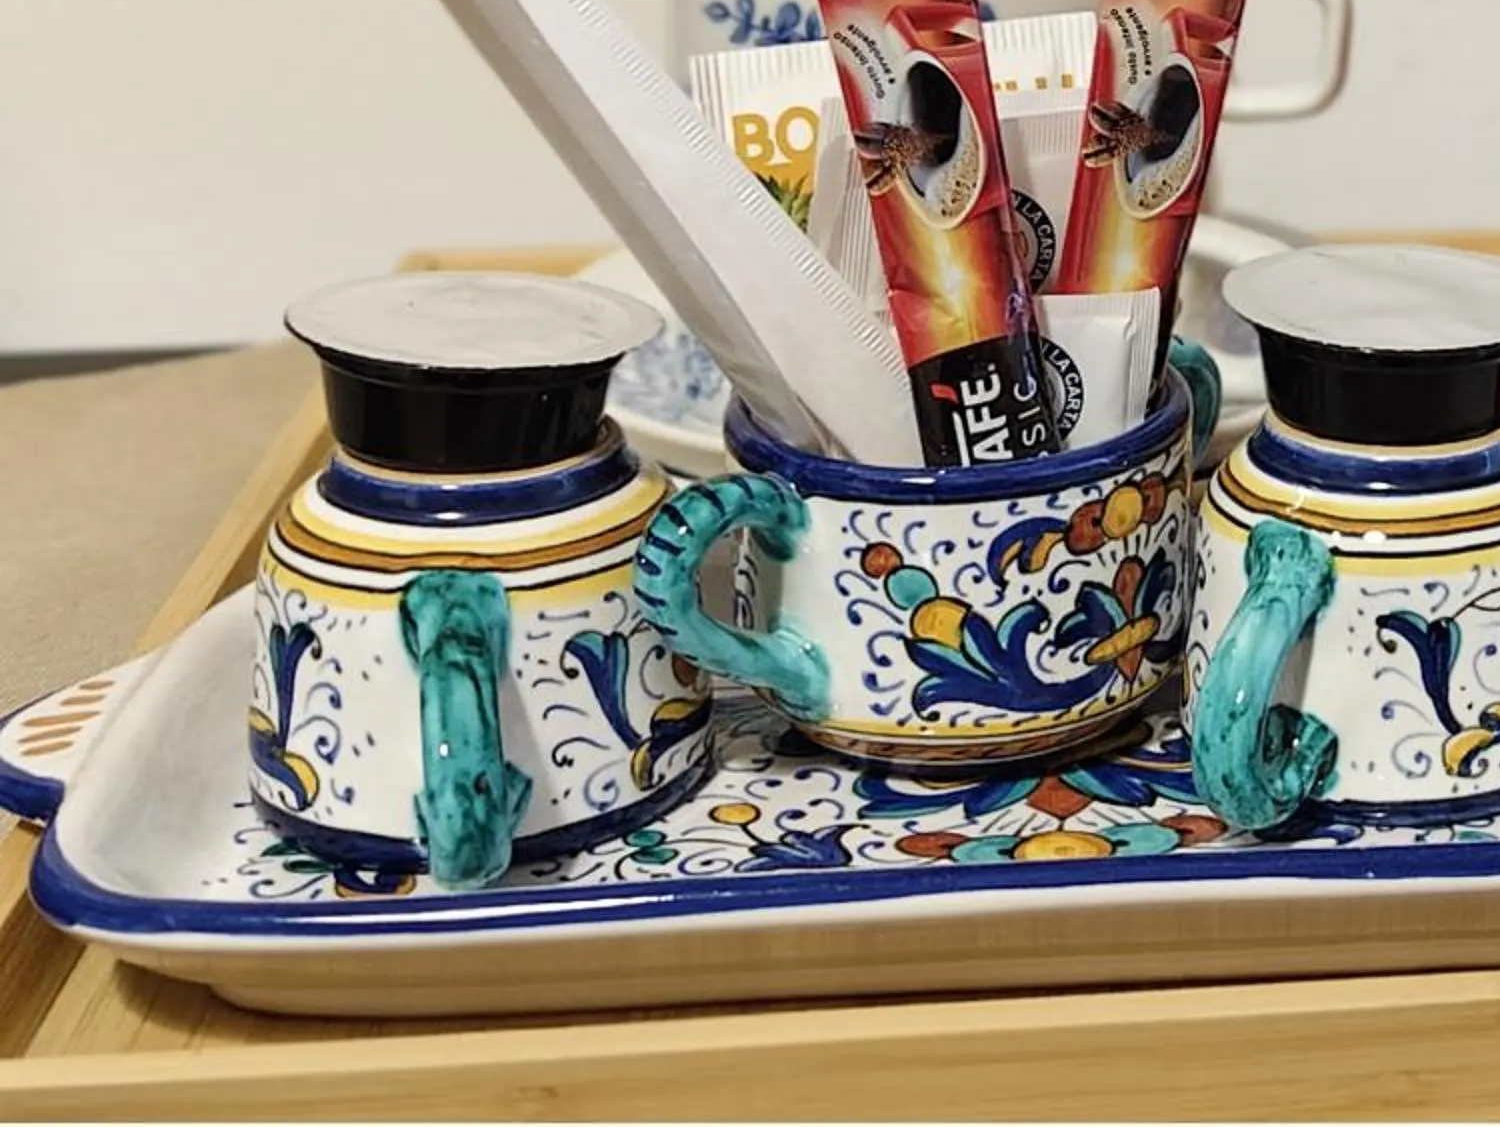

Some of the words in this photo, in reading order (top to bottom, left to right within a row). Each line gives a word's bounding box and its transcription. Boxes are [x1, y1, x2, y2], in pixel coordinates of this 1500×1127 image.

[1022, 201, 1042, 224] LA
[1030, 224, 1054, 280] CARTA
[1049, 348, 1071, 372] LA
[1059, 373, 1081, 430] CARTA
